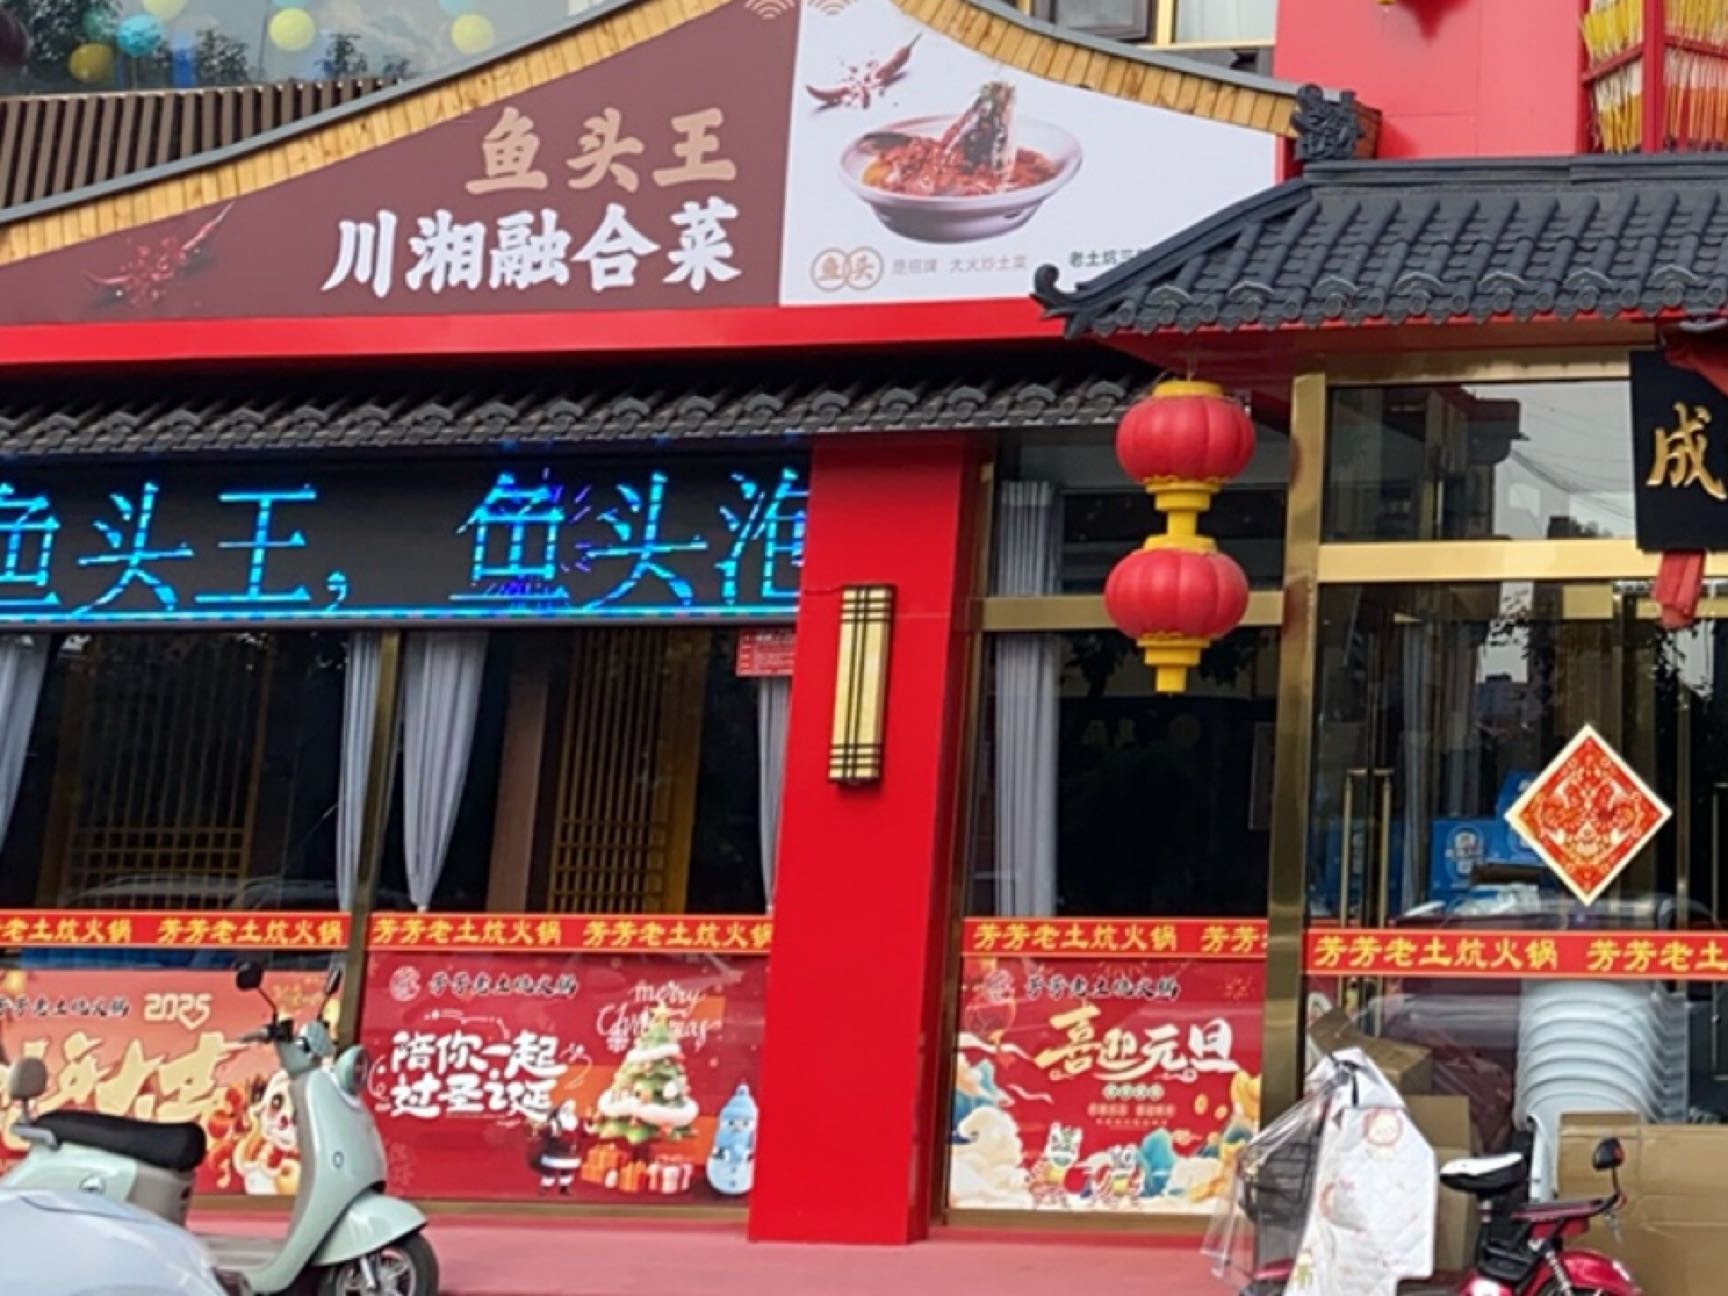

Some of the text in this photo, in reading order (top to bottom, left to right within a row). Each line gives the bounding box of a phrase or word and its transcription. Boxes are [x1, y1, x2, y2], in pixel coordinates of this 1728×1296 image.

[465, 106, 737, 195] 鱼头王
[321, 196, 742, 298] 川湘融合菜
[0, 918, 131, 944] 老土炕火锅
[973, 923, 1267, 953] 芳芳老土炕火锅 芳芳
[1314, 936, 1559, 970] 芳芳老土炕火锅
[143, 992, 213, 1031] 2025
[390, 1030, 568, 1079] 陪你一起
[1034, 1001, 1241, 1082] 喜迎元旦
[390, 1071, 557, 1119] 过圣诞
